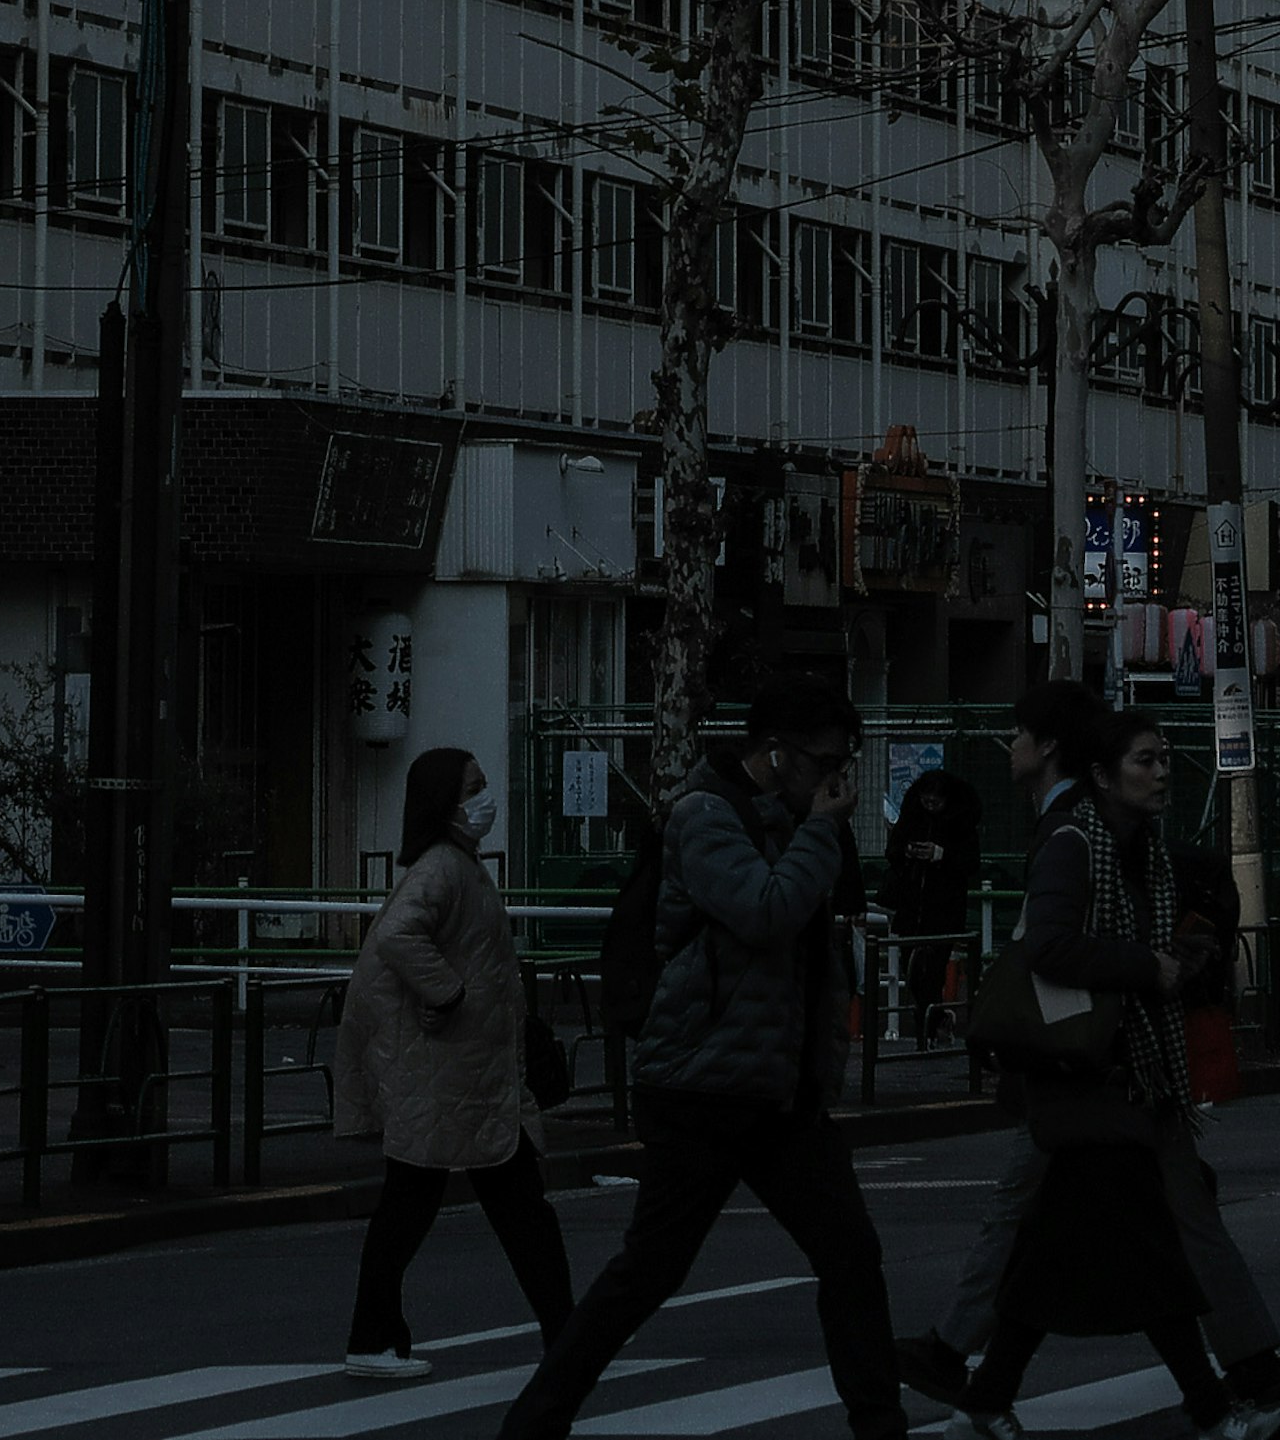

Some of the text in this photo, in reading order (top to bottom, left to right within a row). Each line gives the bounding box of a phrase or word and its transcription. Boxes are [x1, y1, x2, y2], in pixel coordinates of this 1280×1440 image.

[1215, 577, 1231, 655] 不動産仲介
[1229, 574, 1245, 656] ユニマットの
[349, 634, 378, 717] 大衆
